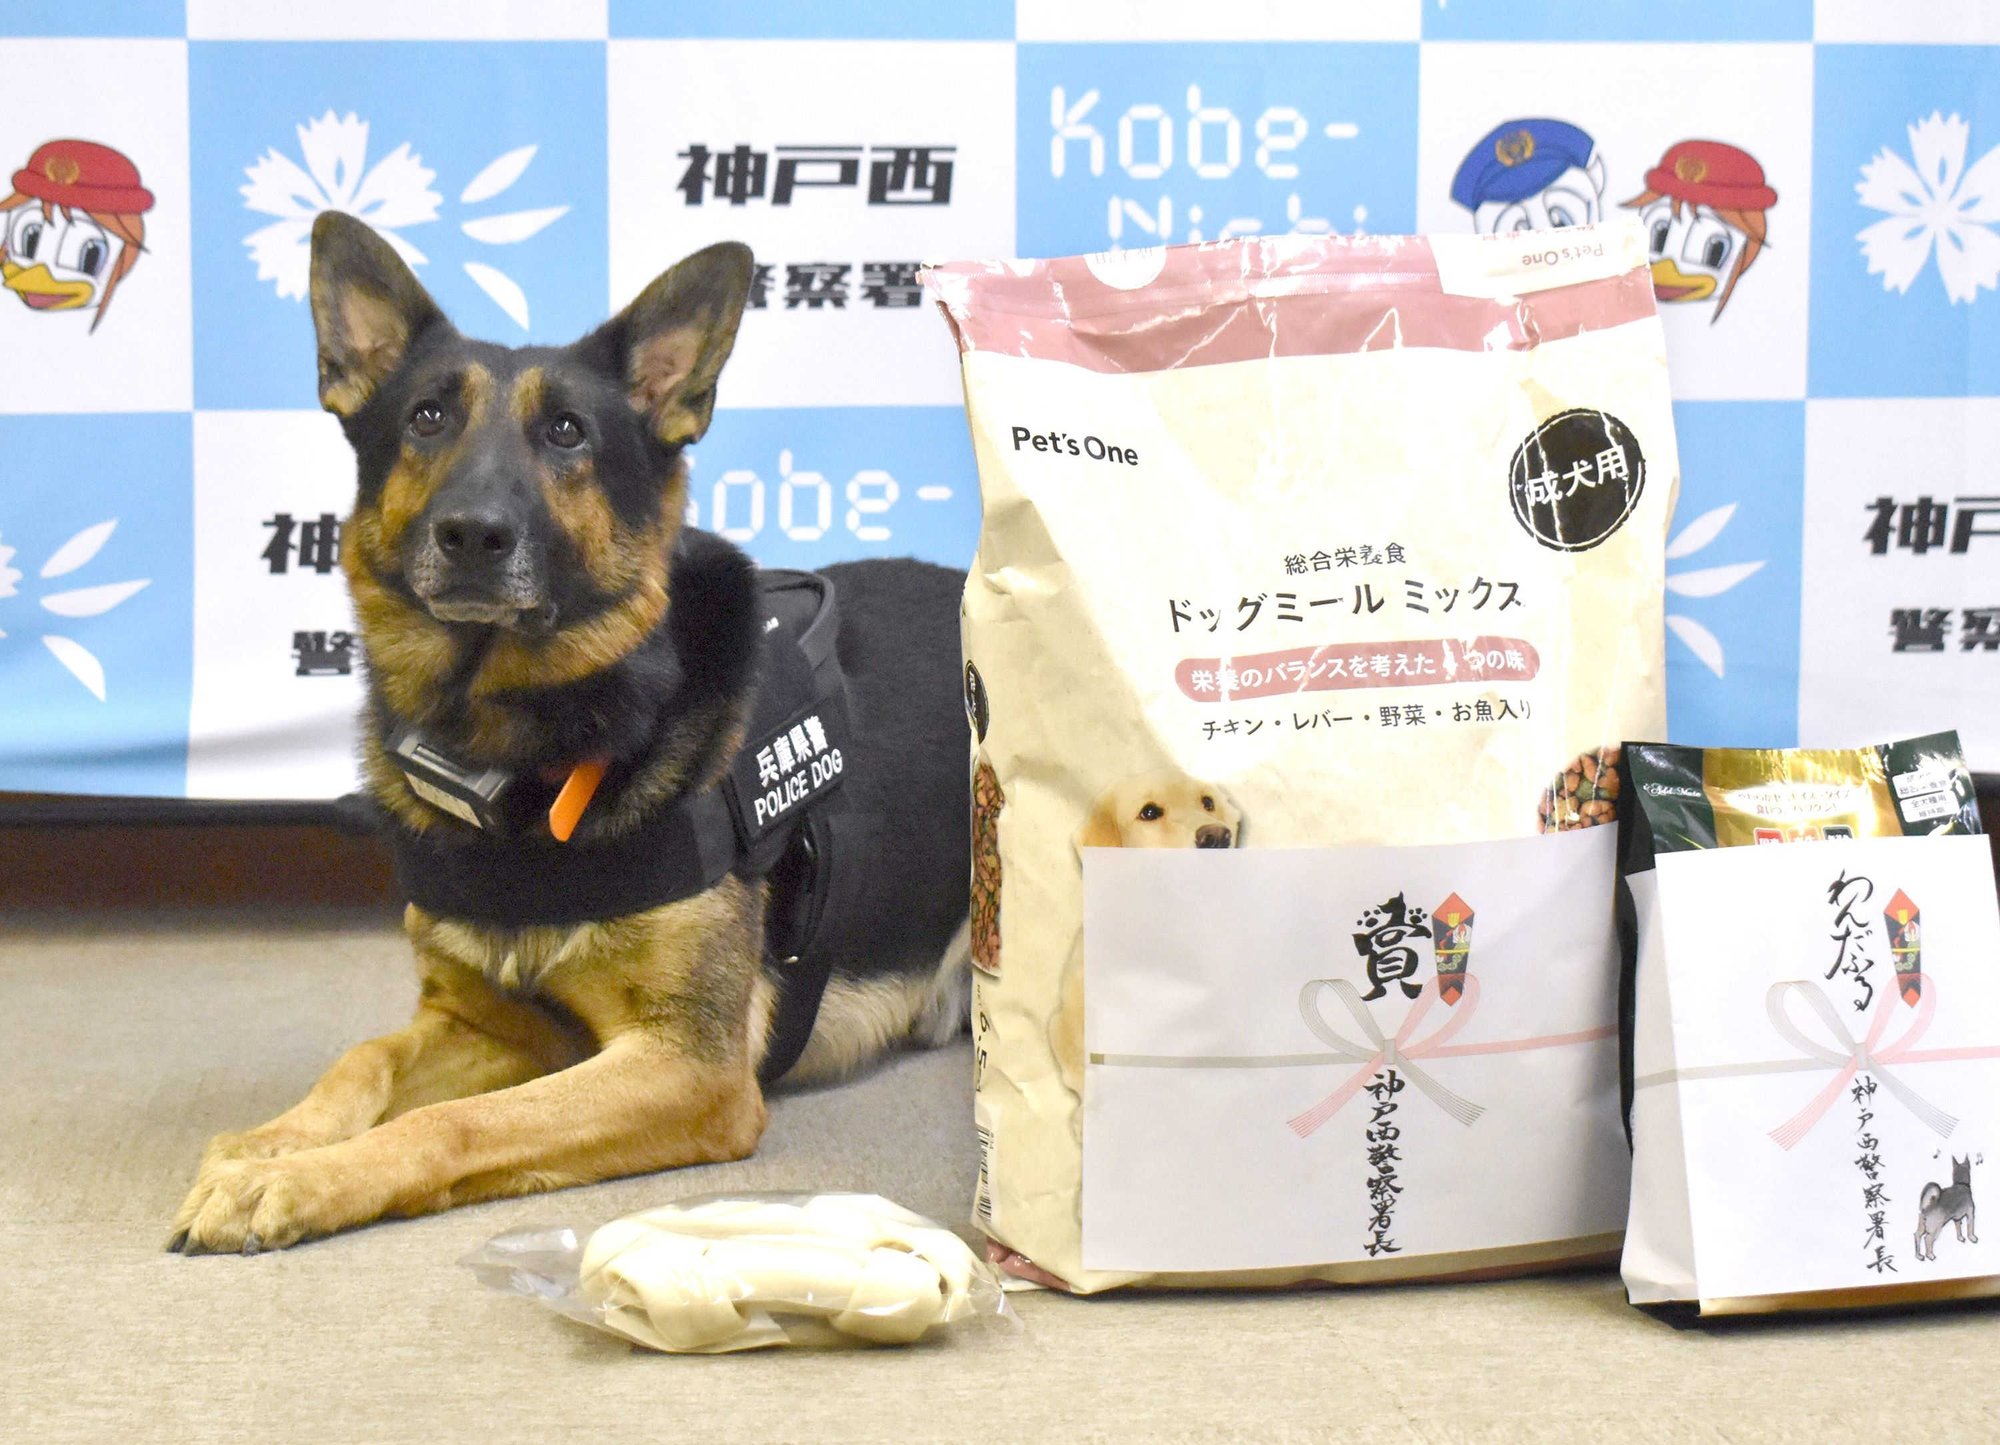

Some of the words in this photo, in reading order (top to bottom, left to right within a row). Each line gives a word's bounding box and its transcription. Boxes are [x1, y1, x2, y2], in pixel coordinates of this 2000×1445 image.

[1051, 84, 1360, 180] Kobe-
[677, 144, 957, 206] 神戸西
[1522, 250, 1560, 267] One
[1011, 425, 1081, 456] Pet's
[1083, 435, 1139, 467] One
[1524, 445, 1629, 508] 成犬用
[686, 448, 953, 542] obe-
[753, 769, 810, 827] POLICE
[811, 748, 844, 790] DOG
[1851, 1075, 1899, 1274] 神戸西警察署長
